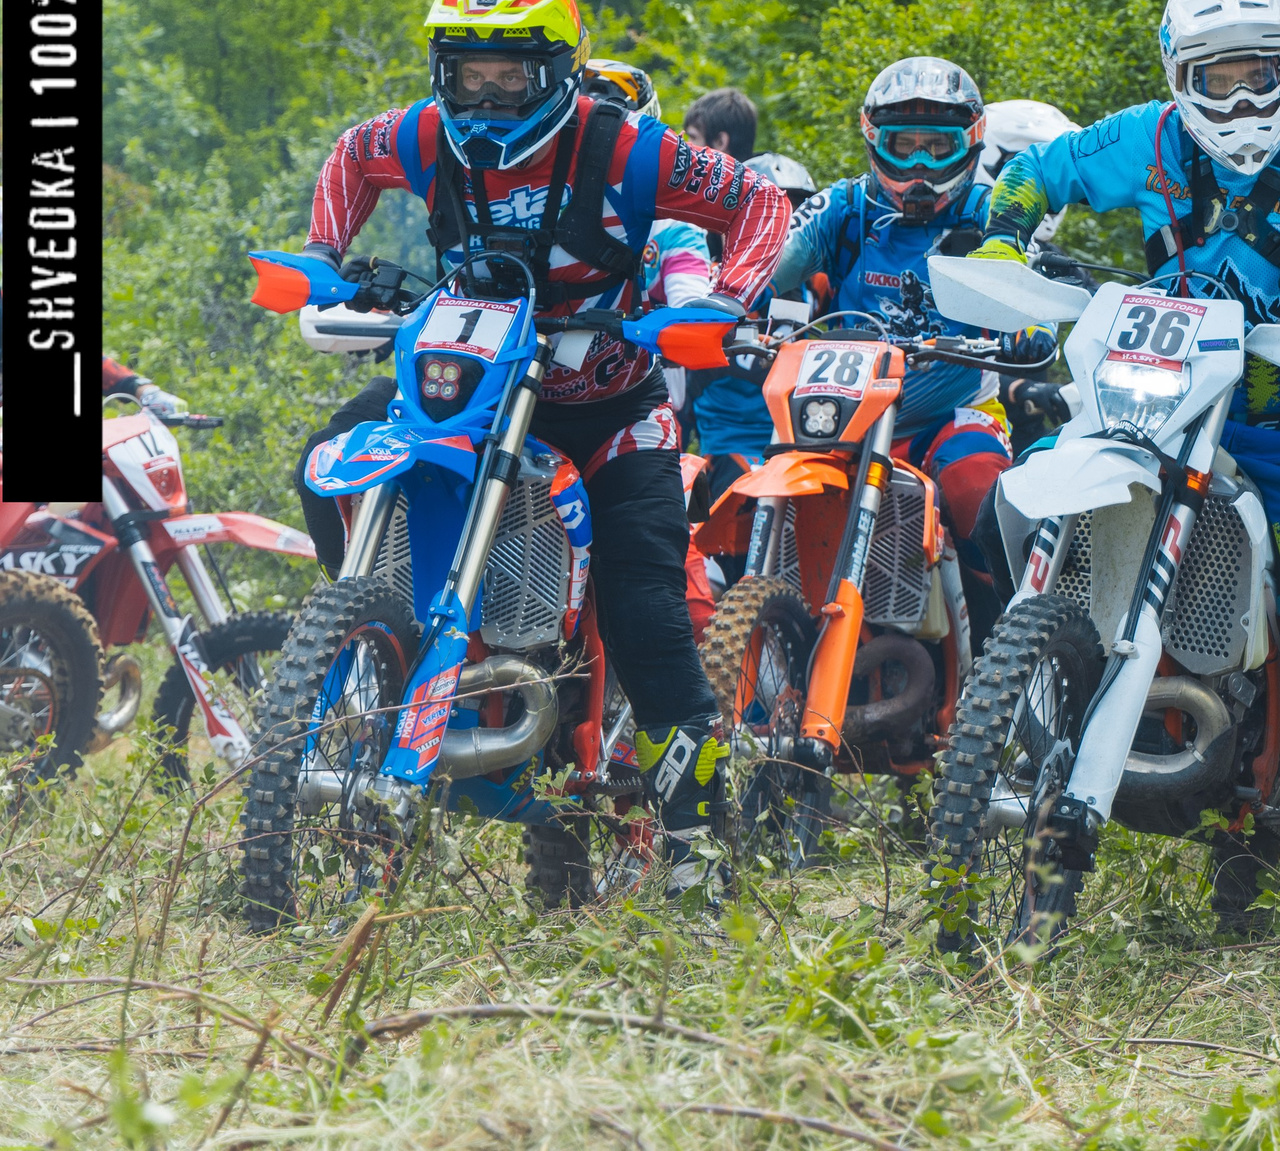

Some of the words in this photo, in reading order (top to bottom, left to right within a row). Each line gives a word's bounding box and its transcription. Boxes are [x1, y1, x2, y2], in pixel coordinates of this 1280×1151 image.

[1125, 297, 1174, 308] «ЗОЛОТАЯ
[1174, 303, 1204, 314] ГОРА»
[455, 309, 483, 344] 1
[1118, 305, 1190, 357] 36
[807, 350, 864, 386] 28
